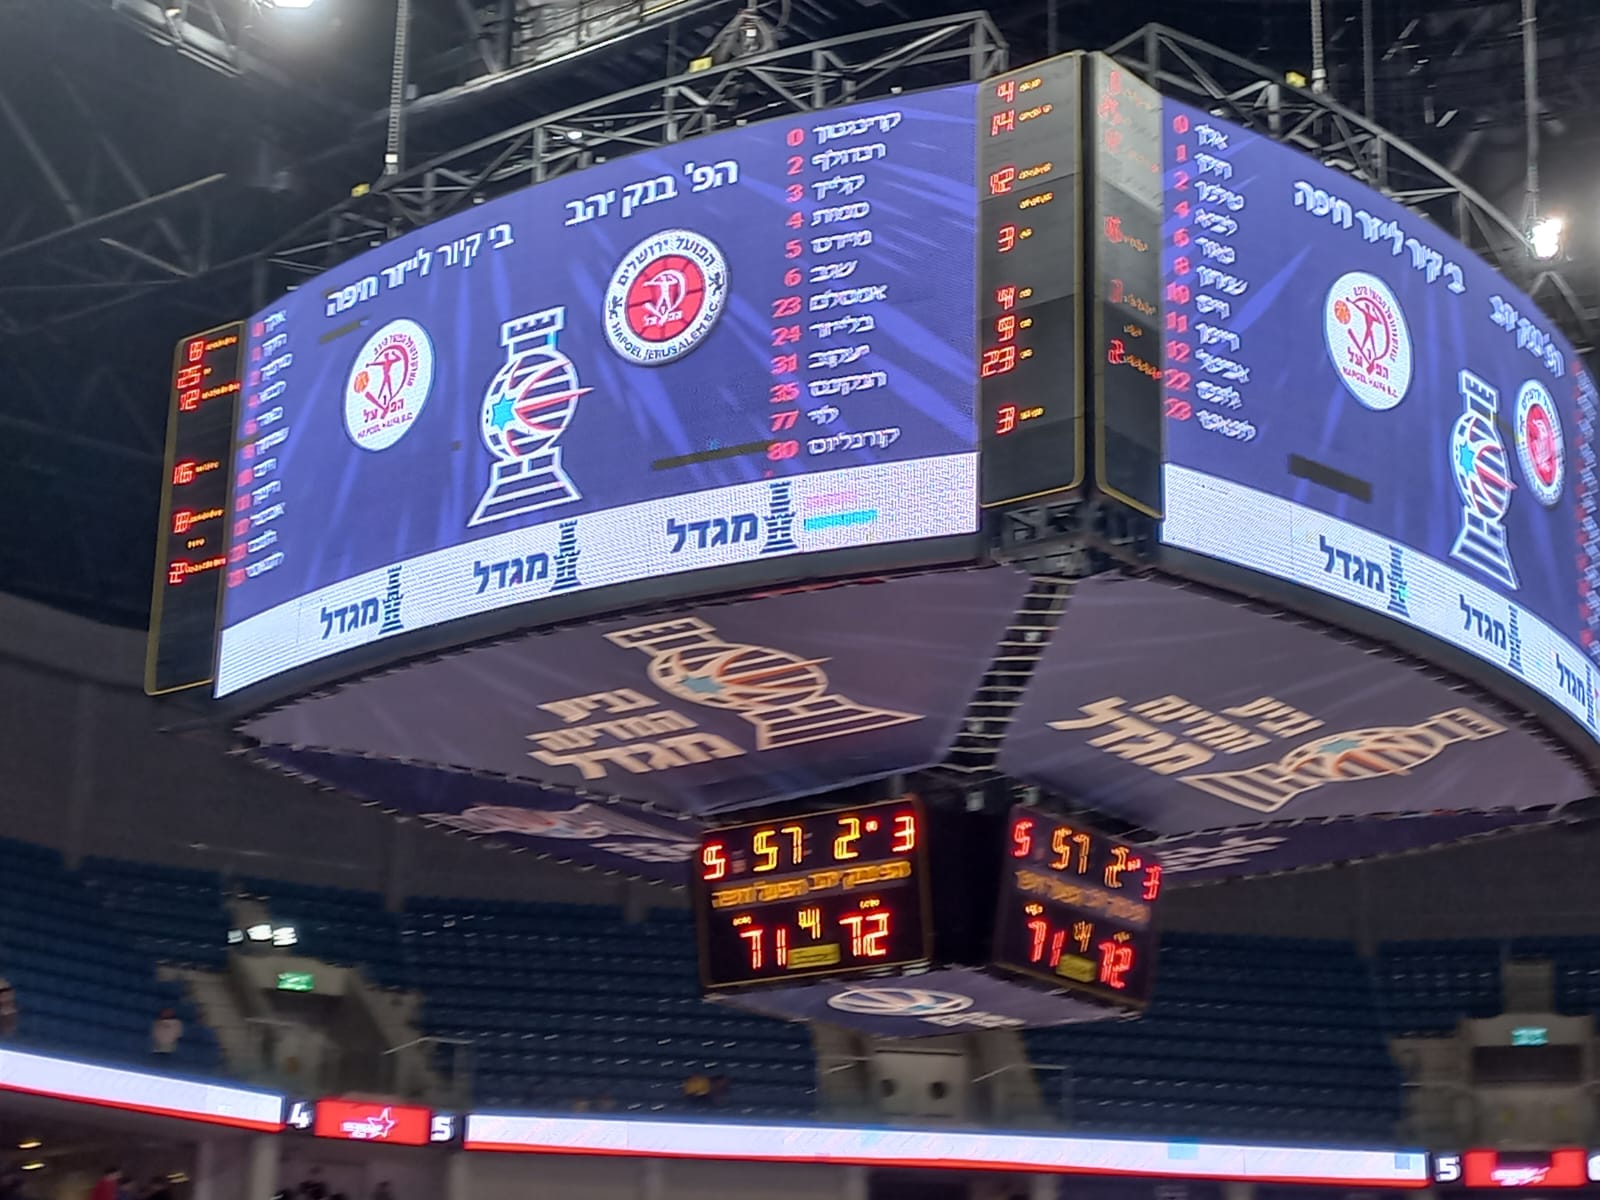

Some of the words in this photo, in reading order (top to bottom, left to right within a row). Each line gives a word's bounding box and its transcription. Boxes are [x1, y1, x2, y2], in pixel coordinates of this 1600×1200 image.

[997, 80, 1015, 103] 4
[787, 128, 806, 147] 0
[990, 109, 1016, 137] 14
[1172, 114, 1189, 134] 0
[787, 156, 805, 176] 2
[1175, 143, 1188, 163] 1
[684, 160, 740, 193] הפ'
[1173, 170, 1190, 192] 2
[564, 190, 616, 226] יהב
[621, 174, 678, 218] בנק
[785, 184, 804, 203] 3
[1293, 180, 1353, 230] חיפה
[785, 211, 805, 229] 4
[1173, 200, 1190, 218] 4
[998, 224, 1016, 252] 3
[1173, 227, 1191, 248] 6
[1354, 210, 1405, 257] לייזר
[436, 232, 483, 268] קיור
[675, 236, 717, 268] הפועל
[784, 239, 803, 258] 5
[1405, 238, 1443, 284] קיור
[381, 247, 433, 289] לייזר
[616, 239, 670, 288] ירושלים
[783, 268, 802, 287] 6
[1173, 256, 1191, 276] 8
[325, 274, 379, 317] חיפה
[771, 296, 803, 318] 23
[996, 285, 1016, 310] 4
[770, 324, 803, 346] 24
[997, 315, 1016, 342] 9
[1166, 311, 1188, 333] 11
[610, 320, 643, 360] HAPOEL
[643, 323, 708, 361] JERUSALEM
[1166, 339, 1191, 363] 12
[770, 353, 798, 375] 31
[981, 344, 1016, 378] 23
[769, 382, 800, 403] 35
[1163, 368, 1192, 393] 22
[769, 410, 800, 432] 77
[996, 405, 1016, 434] 3
[767, 440, 800, 461] 80
[806, 426, 902, 456] קורנליוס
[665, 512, 760, 554] מגדל
[472, 550, 550, 595] מגדל
[1318, 533, 1386, 594] מגדל
[319, 595, 380, 640] מגדל
[1458, 592, 1508, 650] מגדל
[1555, 652, 1587, 708] מגדל
[1044, 696, 1216, 776] מגדל
[525, 731, 748, 781] מגדל
[703, 844, 727, 881] 5
[753, 826, 803, 873] 57
[834, 817, 861, 860] 2
[892, 815, 916, 853] 3
[1013, 820, 1034, 858] 5
[1049, 827, 1092, 875] 57
[1104, 845, 1130, 889] 2
[1142, 864, 1163, 900] 3
[740, 928, 788, 970] 71
[798, 908, 822, 941] 4
[839, 911, 891, 958] 72
[1028, 919, 1066, 968] 71
[1098, 941, 1133, 990] 72
[287, 1101, 313, 1130] 4
[430, 1115, 455, 1142] 5
[1435, 1155, 1461, 1182] 5
